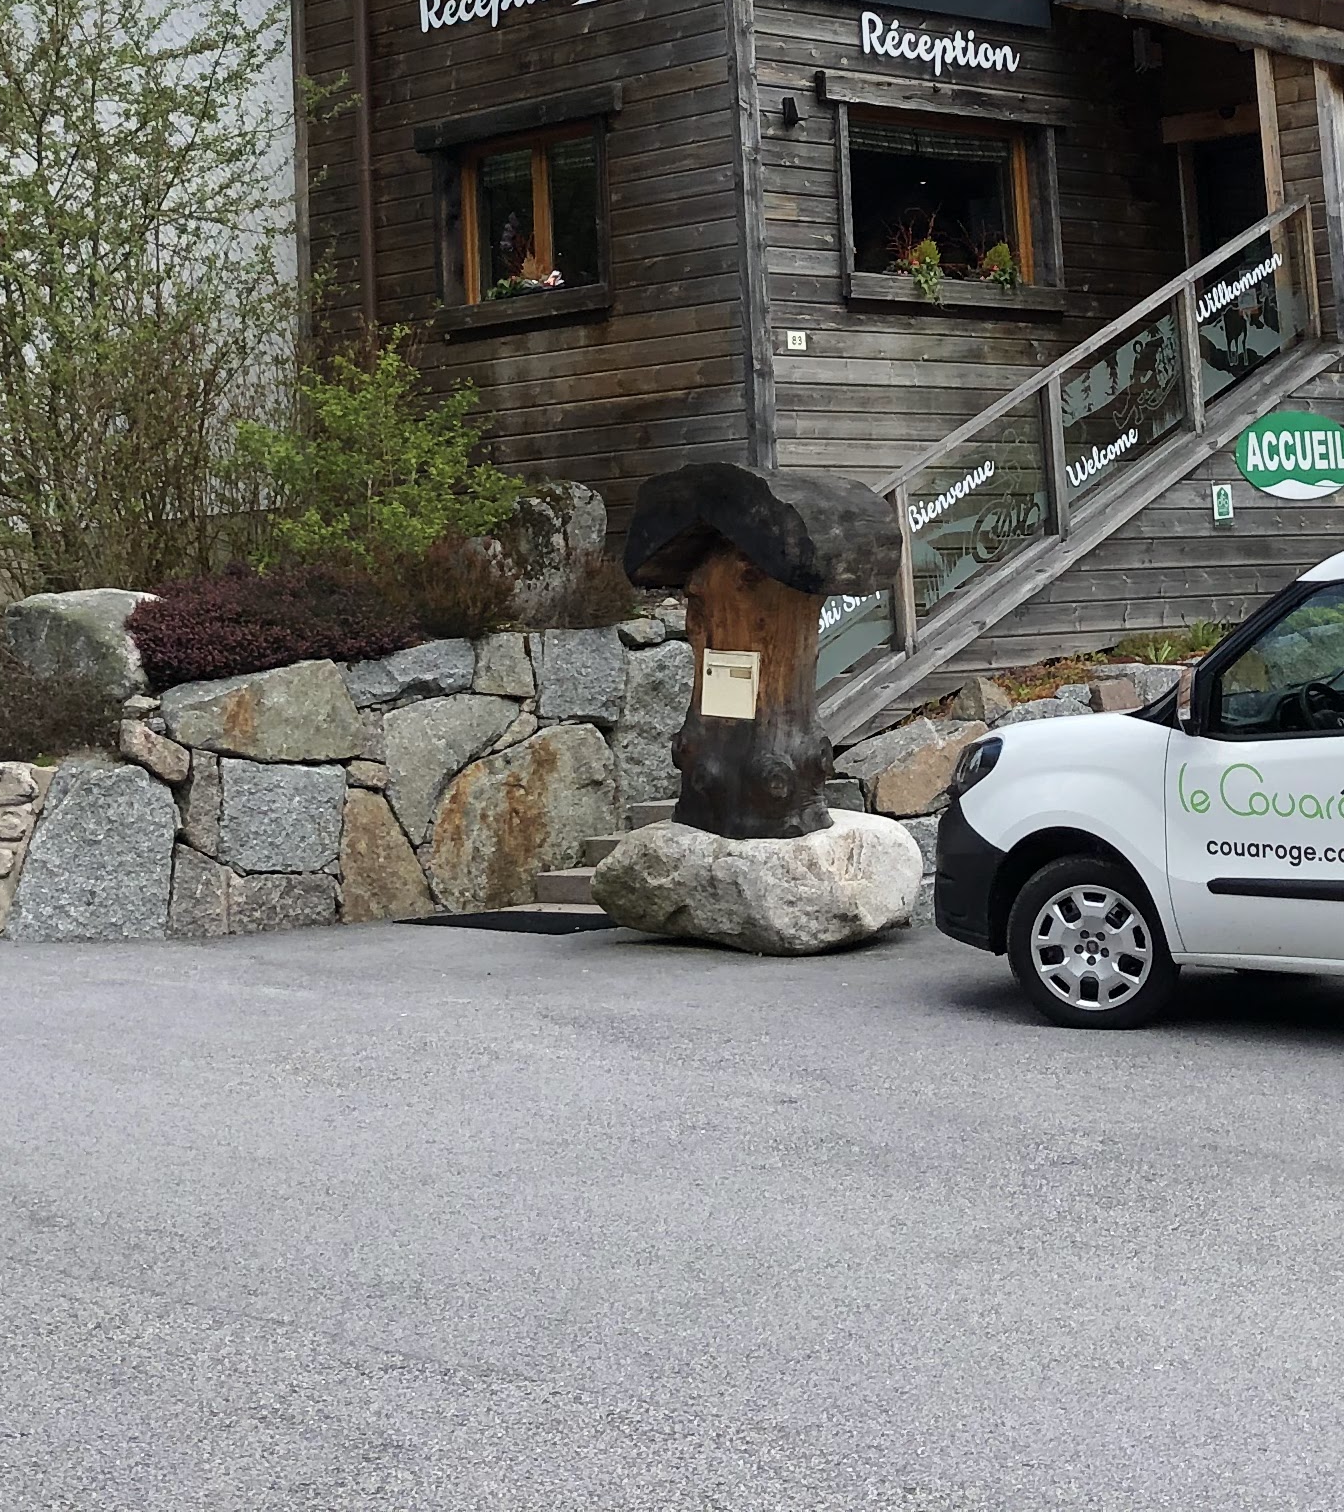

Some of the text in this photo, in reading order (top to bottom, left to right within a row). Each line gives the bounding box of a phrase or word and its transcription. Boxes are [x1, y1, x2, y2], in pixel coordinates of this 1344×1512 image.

[861, 11, 1020, 76] Réception
[1196, 253, 1283, 323] Willkommen
[791, 335, 803, 346] 83
[1065, 428, 1139, 487] Welcome
[908, 460, 995, 533] Bienvenue
[1179, 762, 1211, 814] le
